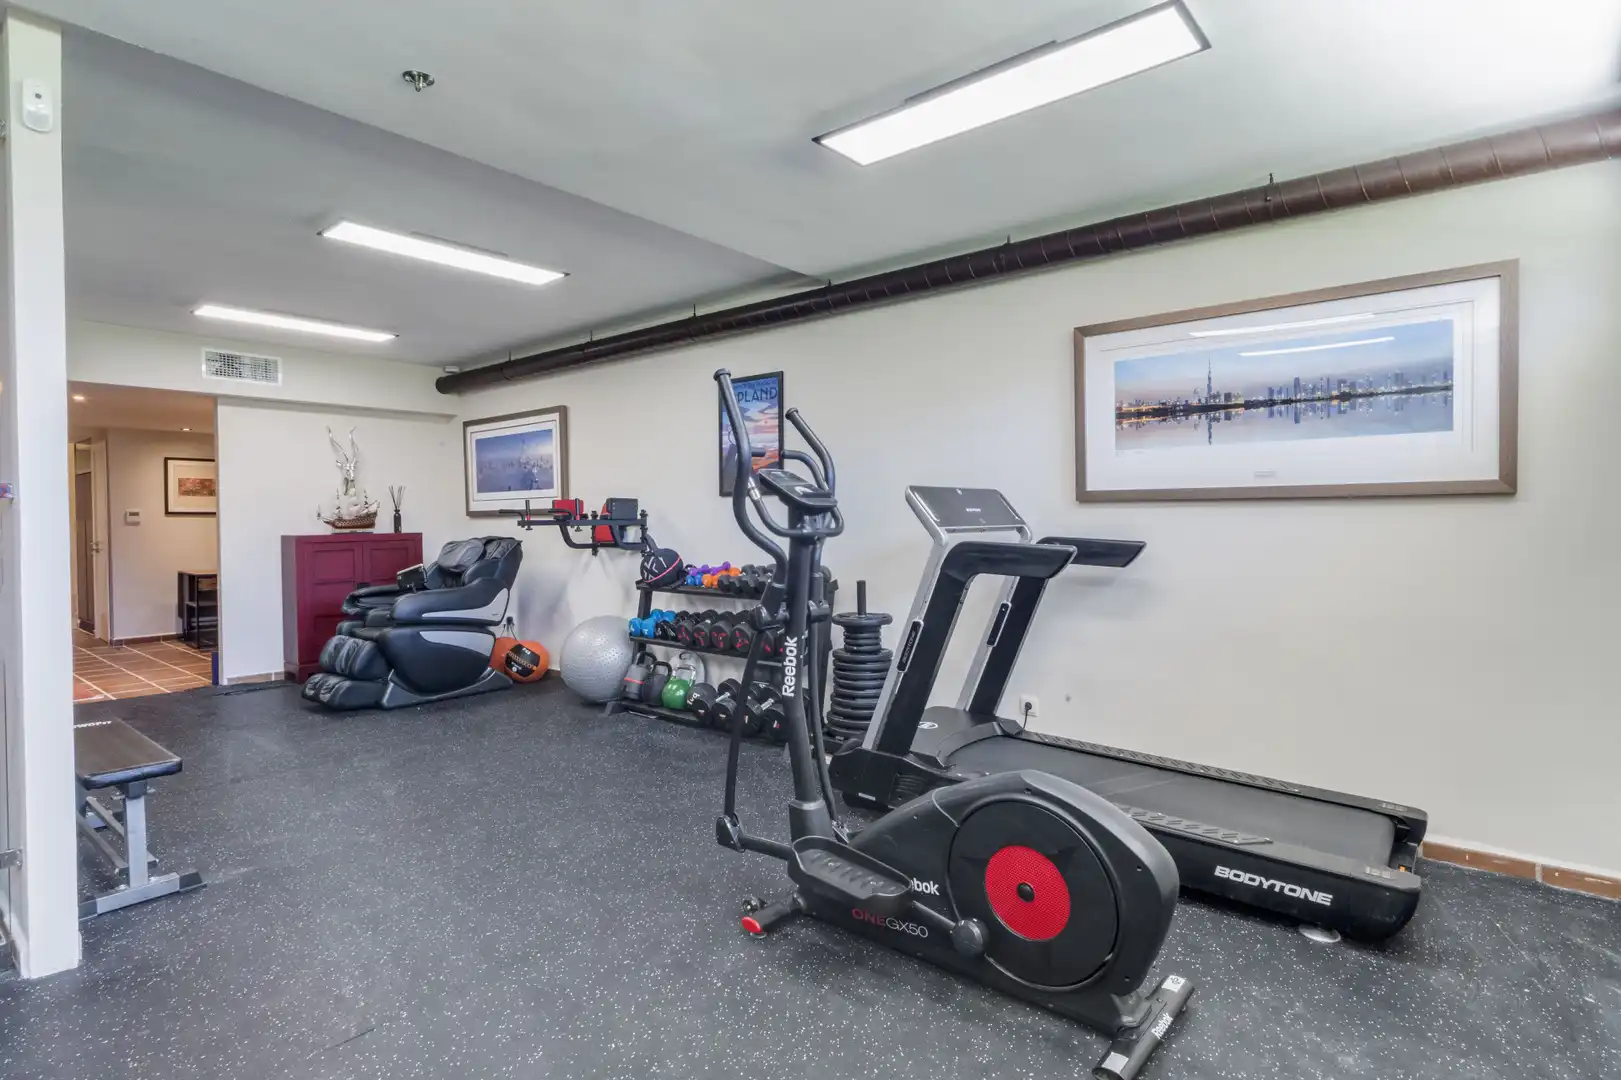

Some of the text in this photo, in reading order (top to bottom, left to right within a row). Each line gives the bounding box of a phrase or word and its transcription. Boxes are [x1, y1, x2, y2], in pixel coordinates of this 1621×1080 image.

[737, 386, 778, 402] PLAND
[782, 635, 798, 697] Reebok
[911, 877, 940, 896] bok
[1214, 865, 1333, 906] BODYTONE
[1151, 1012, 1173, 1039] Reebok
